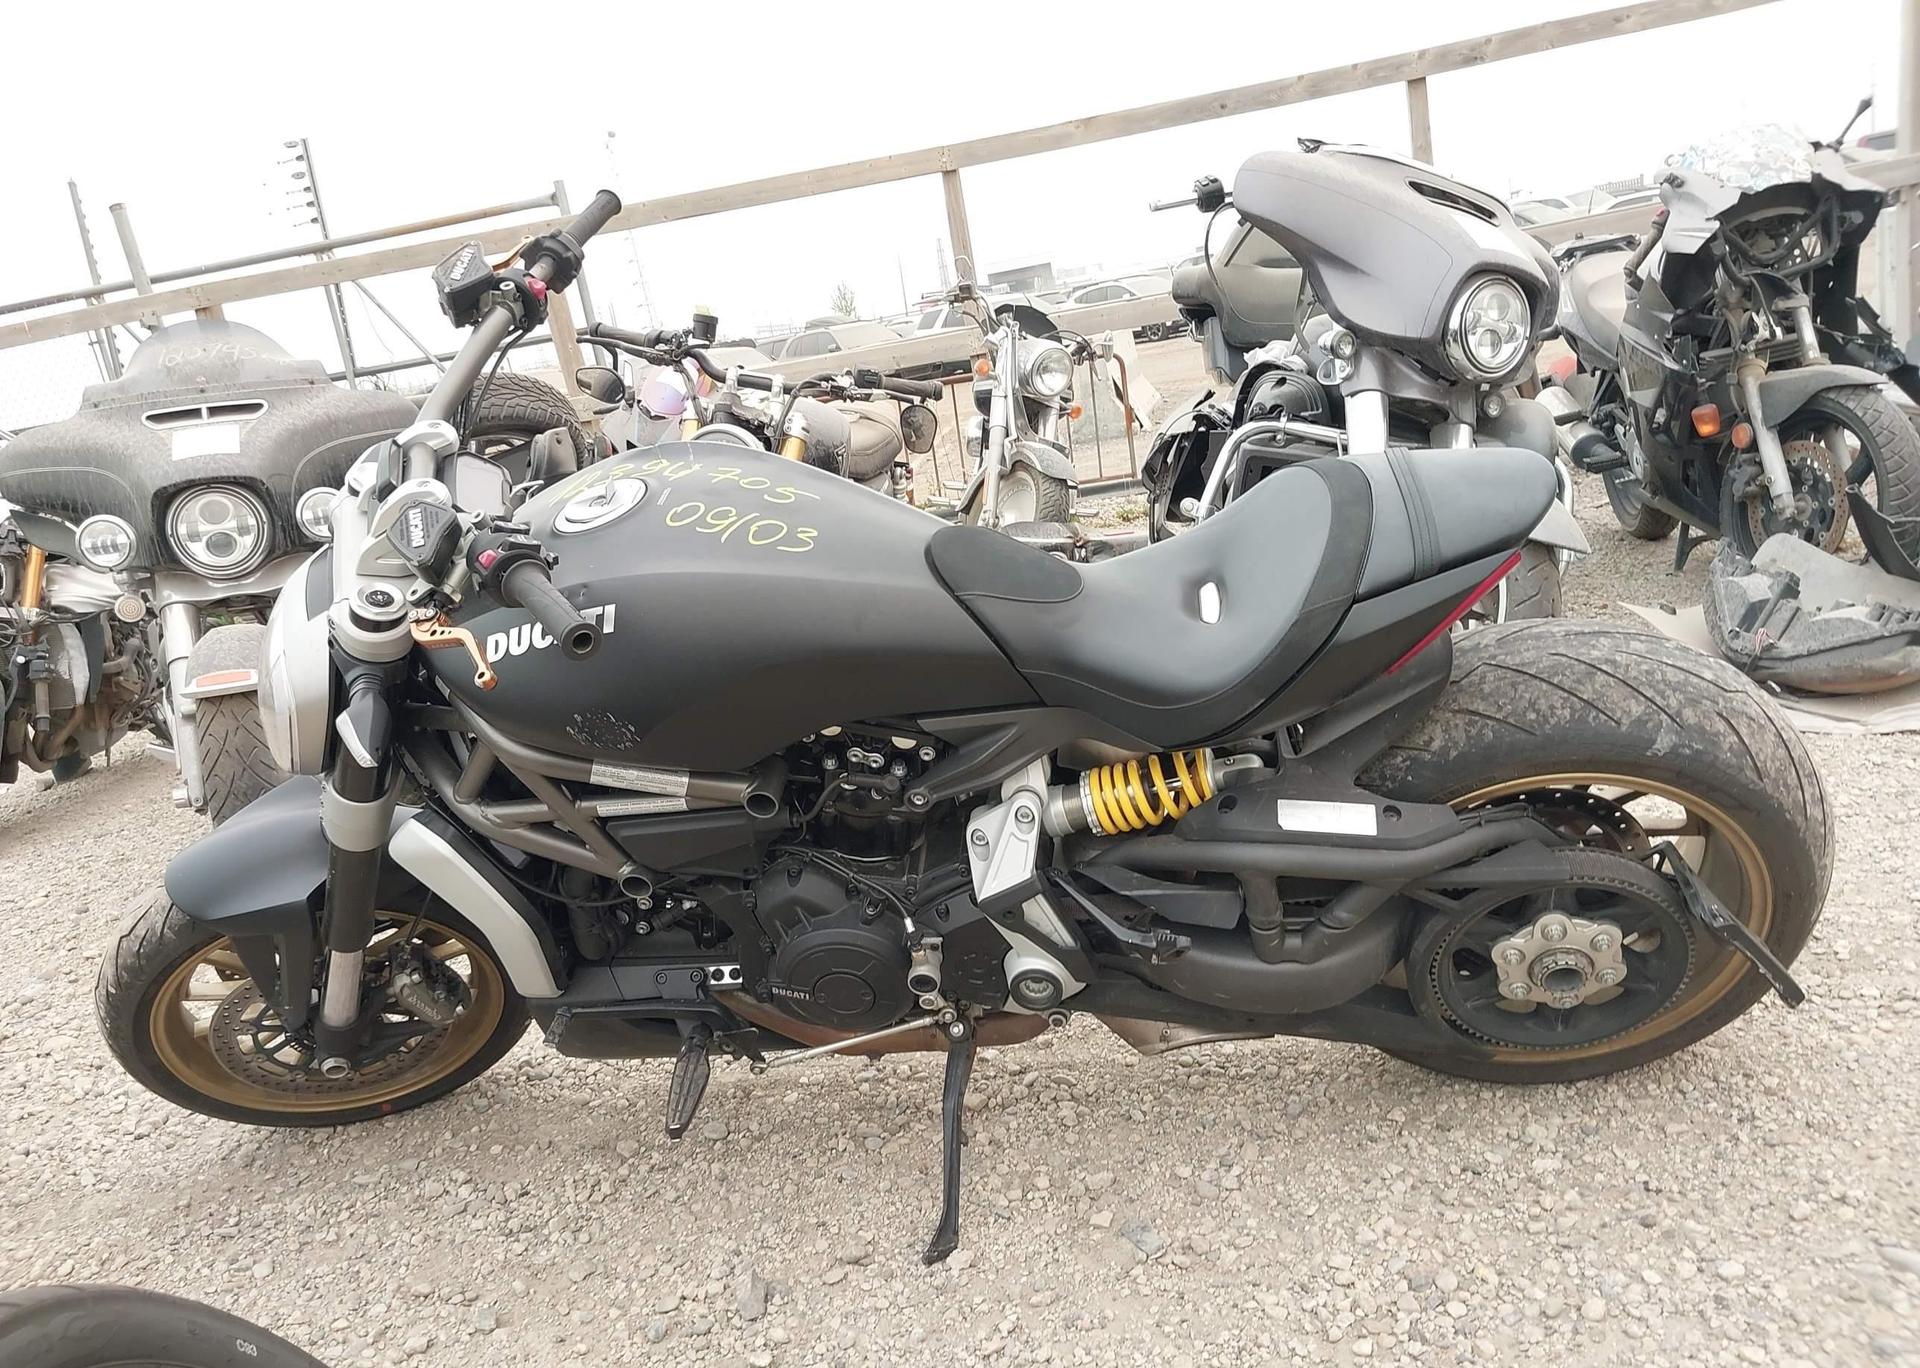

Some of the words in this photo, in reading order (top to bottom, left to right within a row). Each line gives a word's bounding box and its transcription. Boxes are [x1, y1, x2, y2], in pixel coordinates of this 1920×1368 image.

[450, 246, 477, 281] DUCATI
[408, 508, 425, 548] DUCATI
[665, 501, 820, 553] 09/03
[486, 603, 617, 664] DUCTI
[771, 986, 810, 1001] DUCATI
